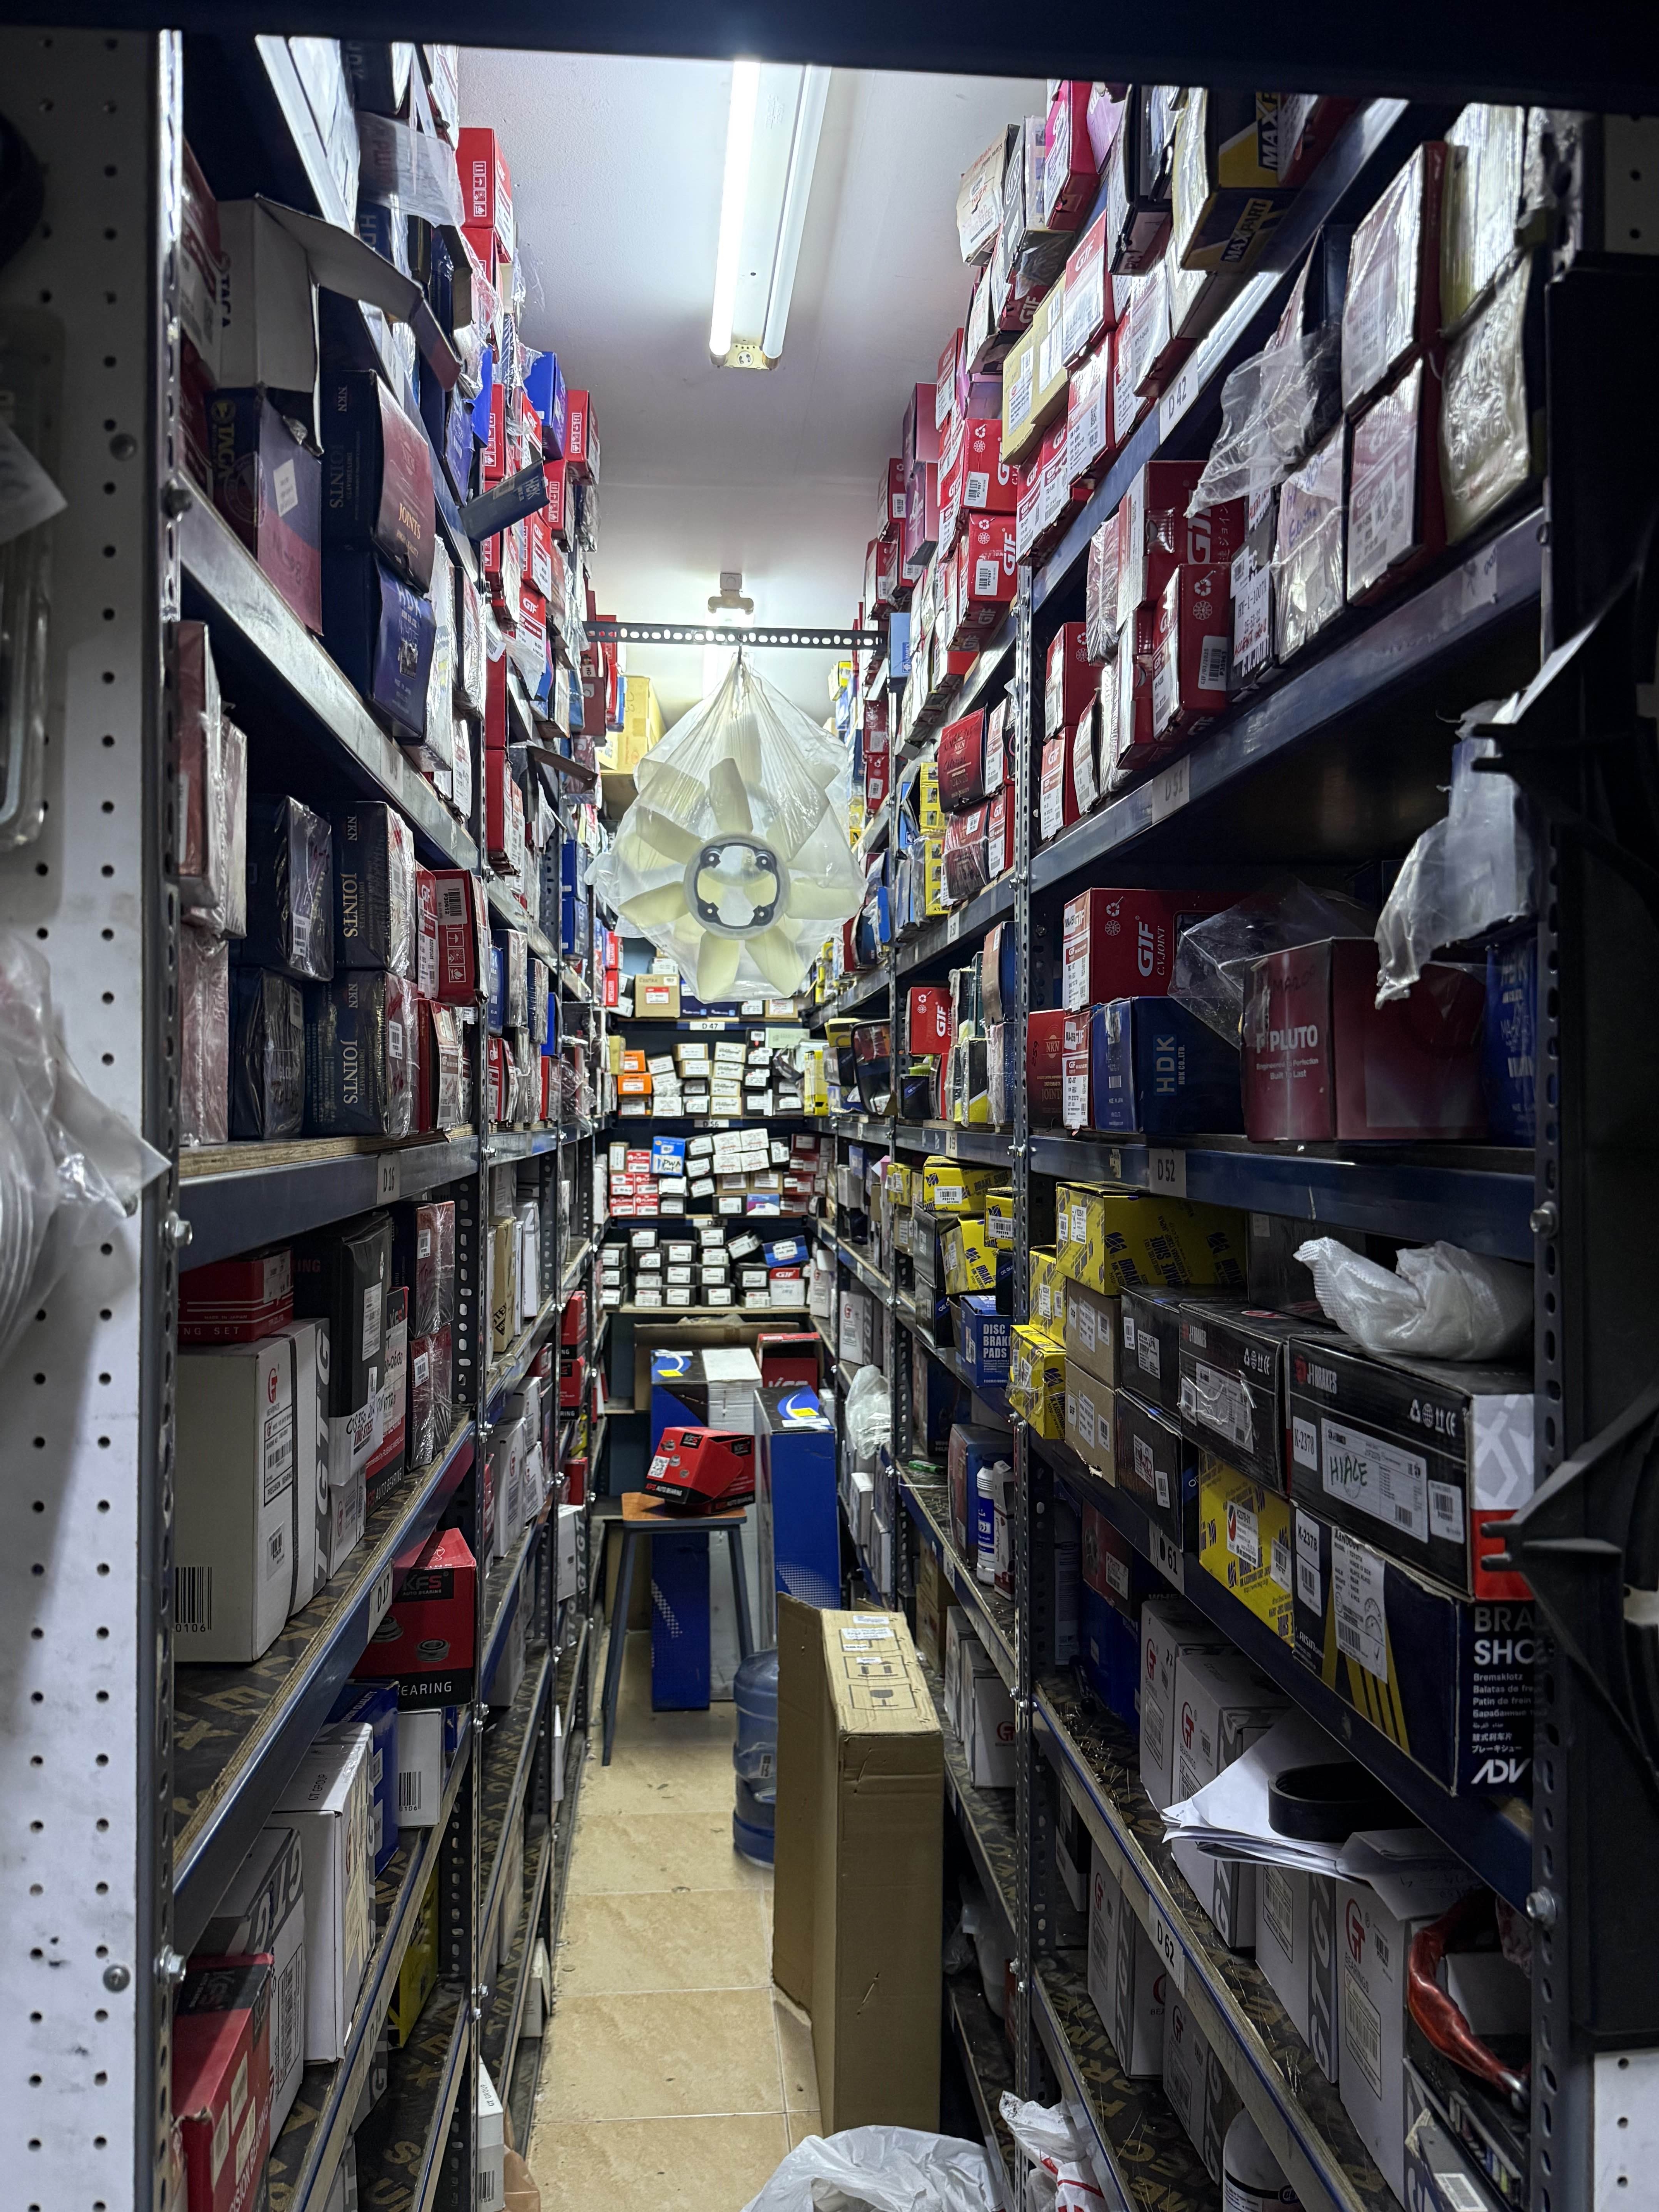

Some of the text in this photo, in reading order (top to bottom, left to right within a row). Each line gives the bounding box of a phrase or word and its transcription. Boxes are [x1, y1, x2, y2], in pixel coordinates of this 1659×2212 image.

[337, 387, 348, 412] NKN
[398, 503, 421, 539] JOINTS
[347, 816, 358, 841] NKN
[341, 872, 358, 938] JOINTS
[1157, 926, 1166, 976] C.V.JOINT
[348, 982, 358, 1008] NKN
[1045, 1041, 1060, 1052] NKN
[1269, 1025, 1318, 1053] PLUTO
[341, 1039, 358, 1105] JOINTS
[1156, 1036, 1175, 1093] HDK
[1293, 1057, 1319, 1066] Perfection
[1178, 1071, 1186, 1085] HDK
[1270, 1071, 1285, 1081] Built
[1293, 1069, 1307, 1079] Last
[1158, 1158, 1175, 1182] D 52
[977, 1265, 994, 1286] BRAKE
[217, 1326, 240, 1338] SET
[983, 1324, 1006, 1335] DISC
[983, 1347, 1007, 1358] PADS
[1294, 1428, 1315, 1455] K-2378
[1329, 1455, 1368, 1486] HIACE
[1298, 1527, 1317, 1552] K-2378
[1168, 1546, 1178, 1575] 61
[403, 1574, 443, 1592] KFS
[175, 1624, 206, 1632] 0106
[1474, 1606, 1534, 1633] BRA
[1299, 1631, 1316, 1649] AISIN
[1474, 1638, 1535, 1666] SHO
[1473, 1673, 1523, 1682] Bremsklotz
[1473, 1697, 1495, 1706] Patin
[1511, 1696, 1532, 1705] frein
[1165, 1934, 1175, 1968] 62
